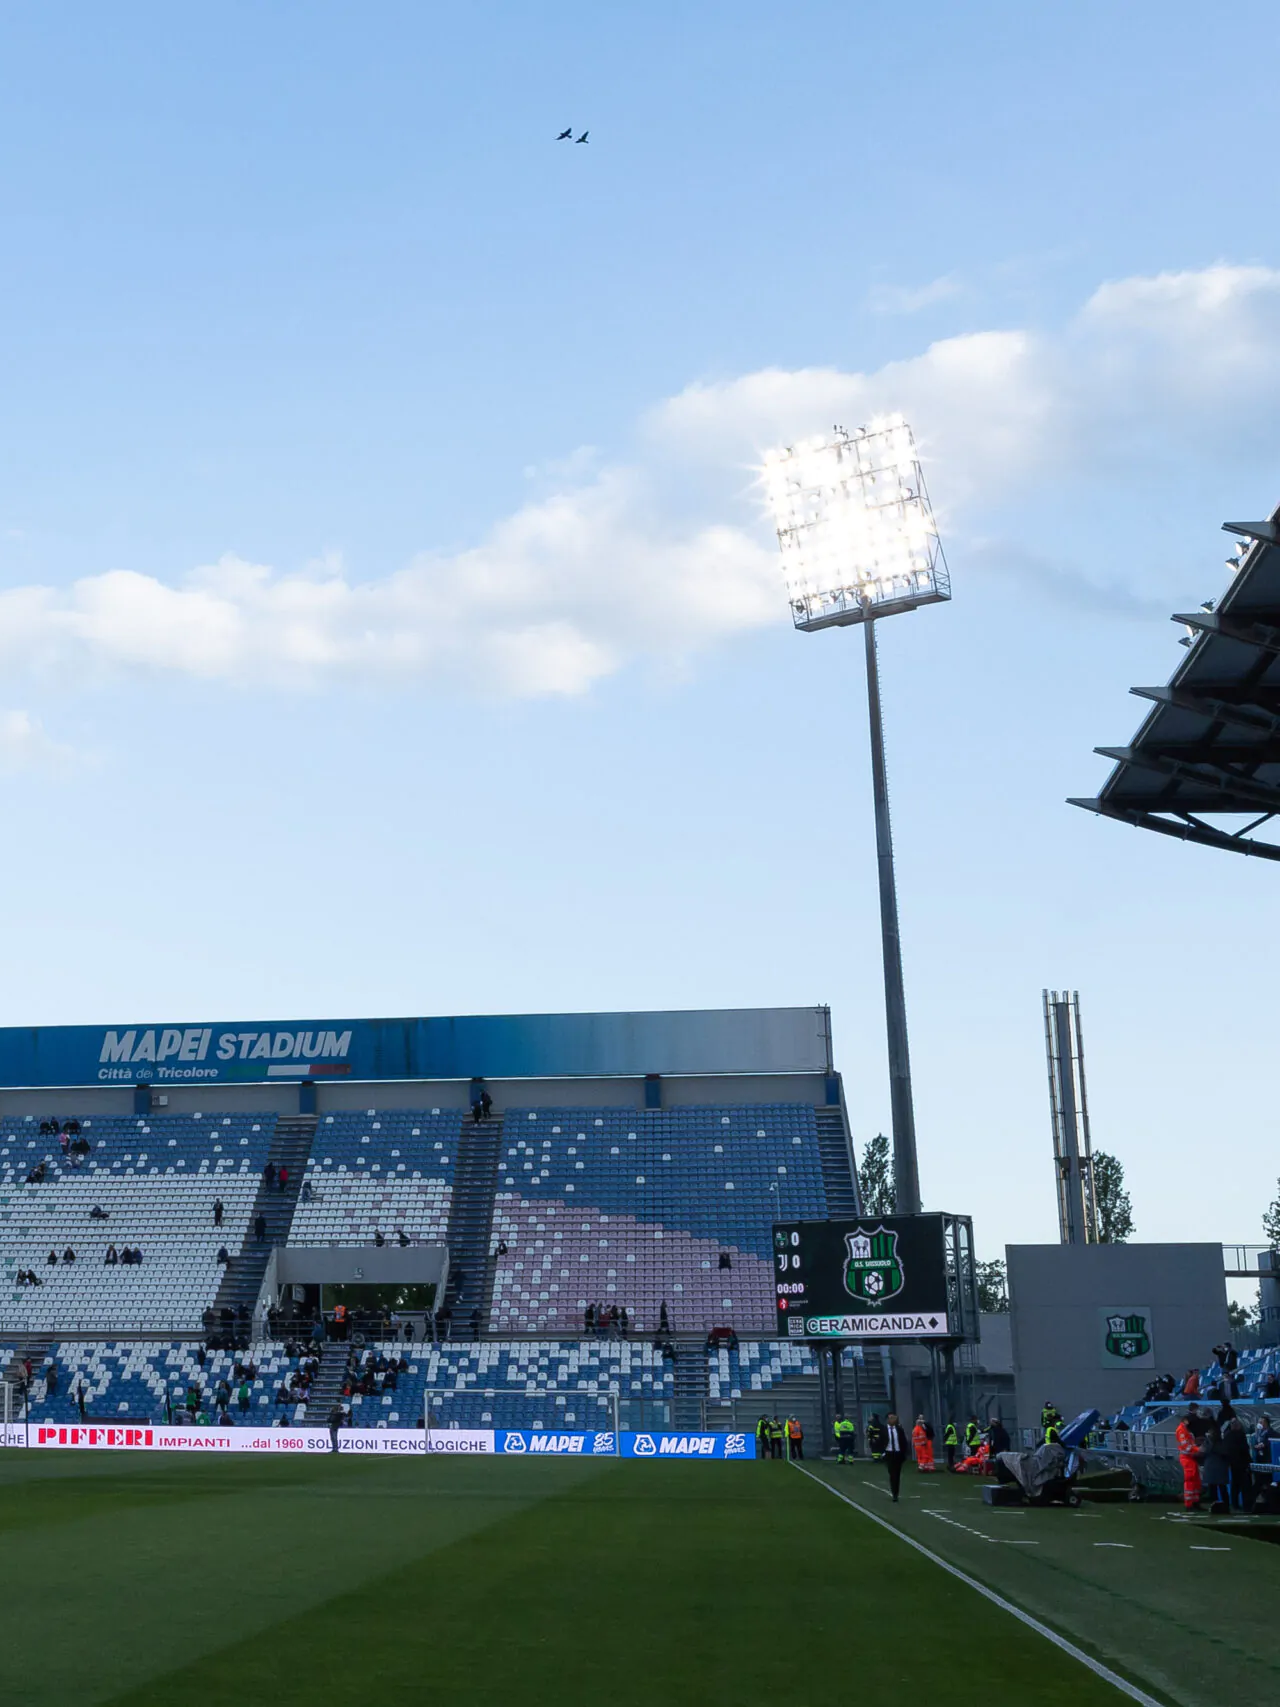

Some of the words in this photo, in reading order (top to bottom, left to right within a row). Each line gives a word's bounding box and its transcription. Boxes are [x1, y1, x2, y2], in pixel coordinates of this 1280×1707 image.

[99, 1028, 212, 1062] MAPEI
[216, 1031, 352, 1060] STADIUM
[98, 1068, 132, 1080] Città
[136, 1068, 153, 1079] dei
[157, 1067, 218, 1078] Tricolore
[791, 1232, 800, 1246] 0
[792, 1254, 801, 1269] 0
[777, 1282, 805, 1294] 00:00
[808, 1317, 926, 1333] CERAMICANDA
[38, 1428, 153, 1446] PIFFERI
[159, 1438, 230, 1448] IMPIANTI
[276, 1438, 304, 1449] 1960
[382, 1439, 487, 1451] TECNOLOGICHE
[529, 1435, 584, 1453] MAPEI
[593, 1432, 615, 1447] 85
[659, 1437, 716, 1454] MAPEI
[724, 1433, 746, 1448] 85
